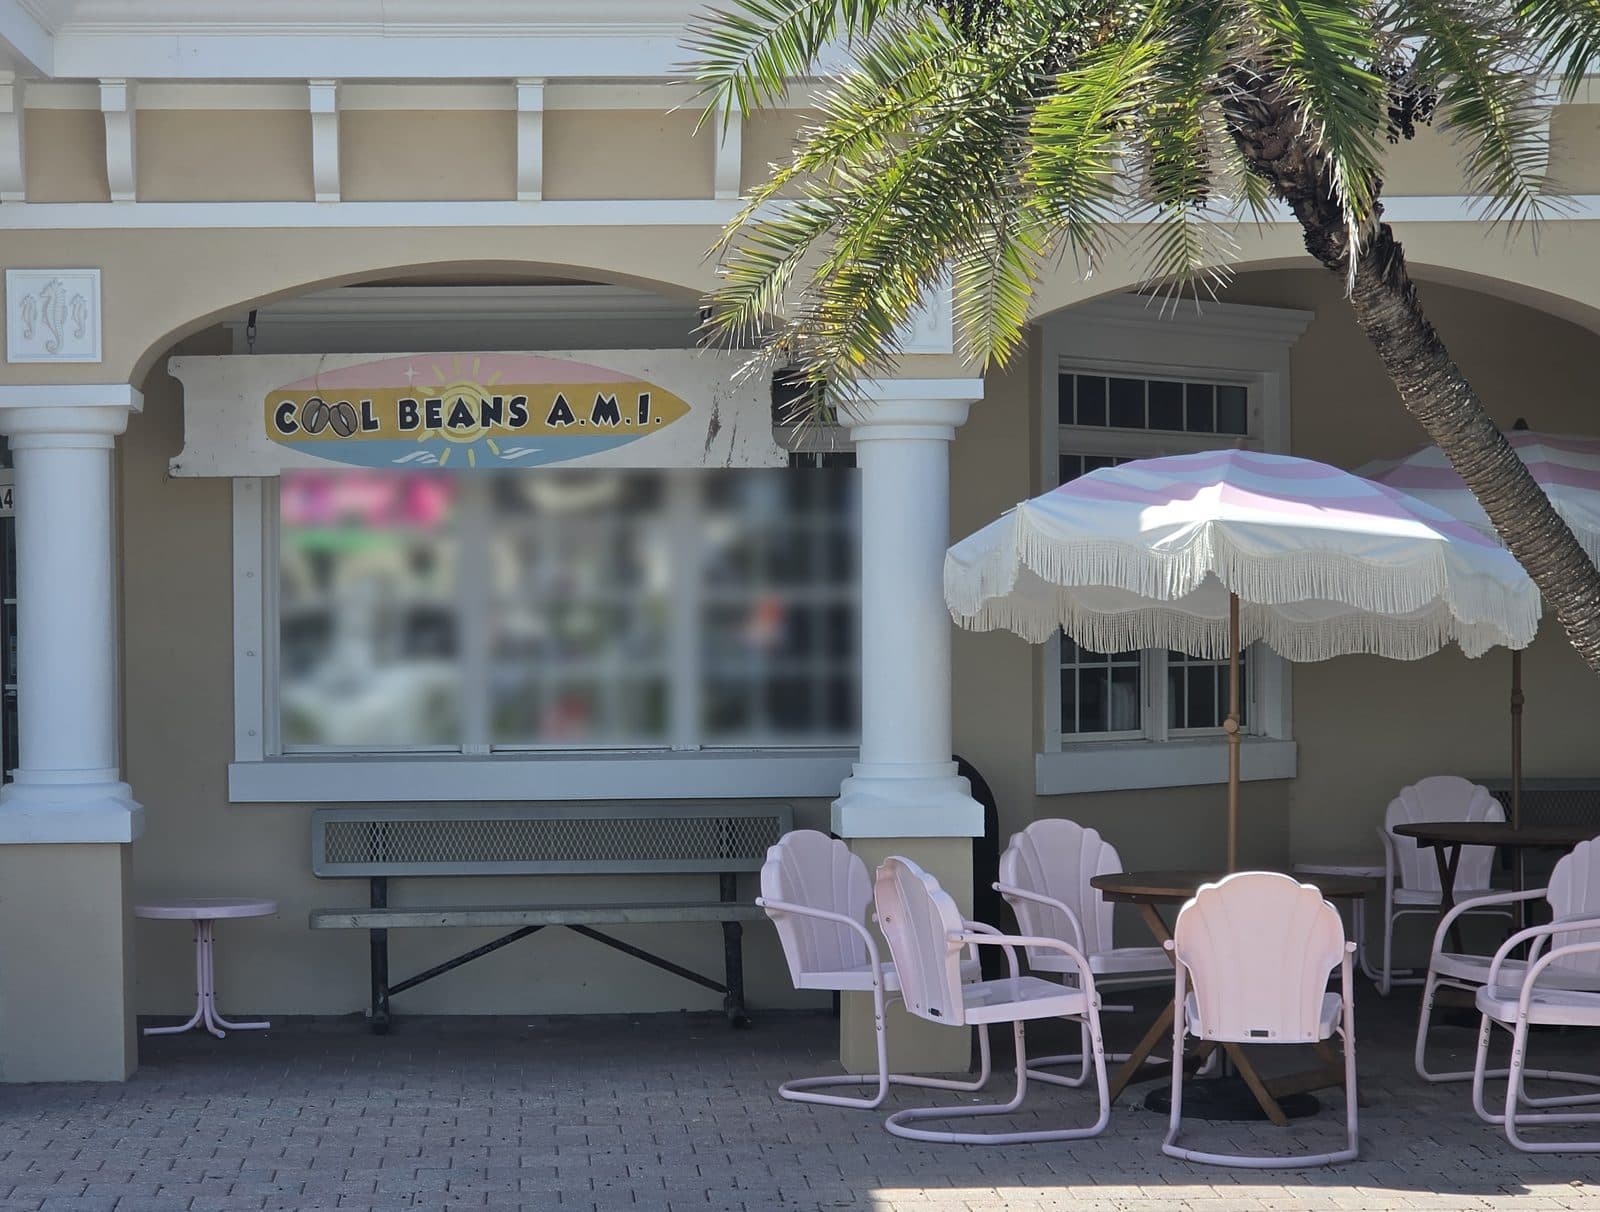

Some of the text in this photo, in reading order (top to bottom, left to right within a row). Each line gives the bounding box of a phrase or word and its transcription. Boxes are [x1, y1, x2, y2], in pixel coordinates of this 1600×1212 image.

[274, 392, 662, 437] COOL BEANS A.M.I.
[0, 488, 13, 509] 4
